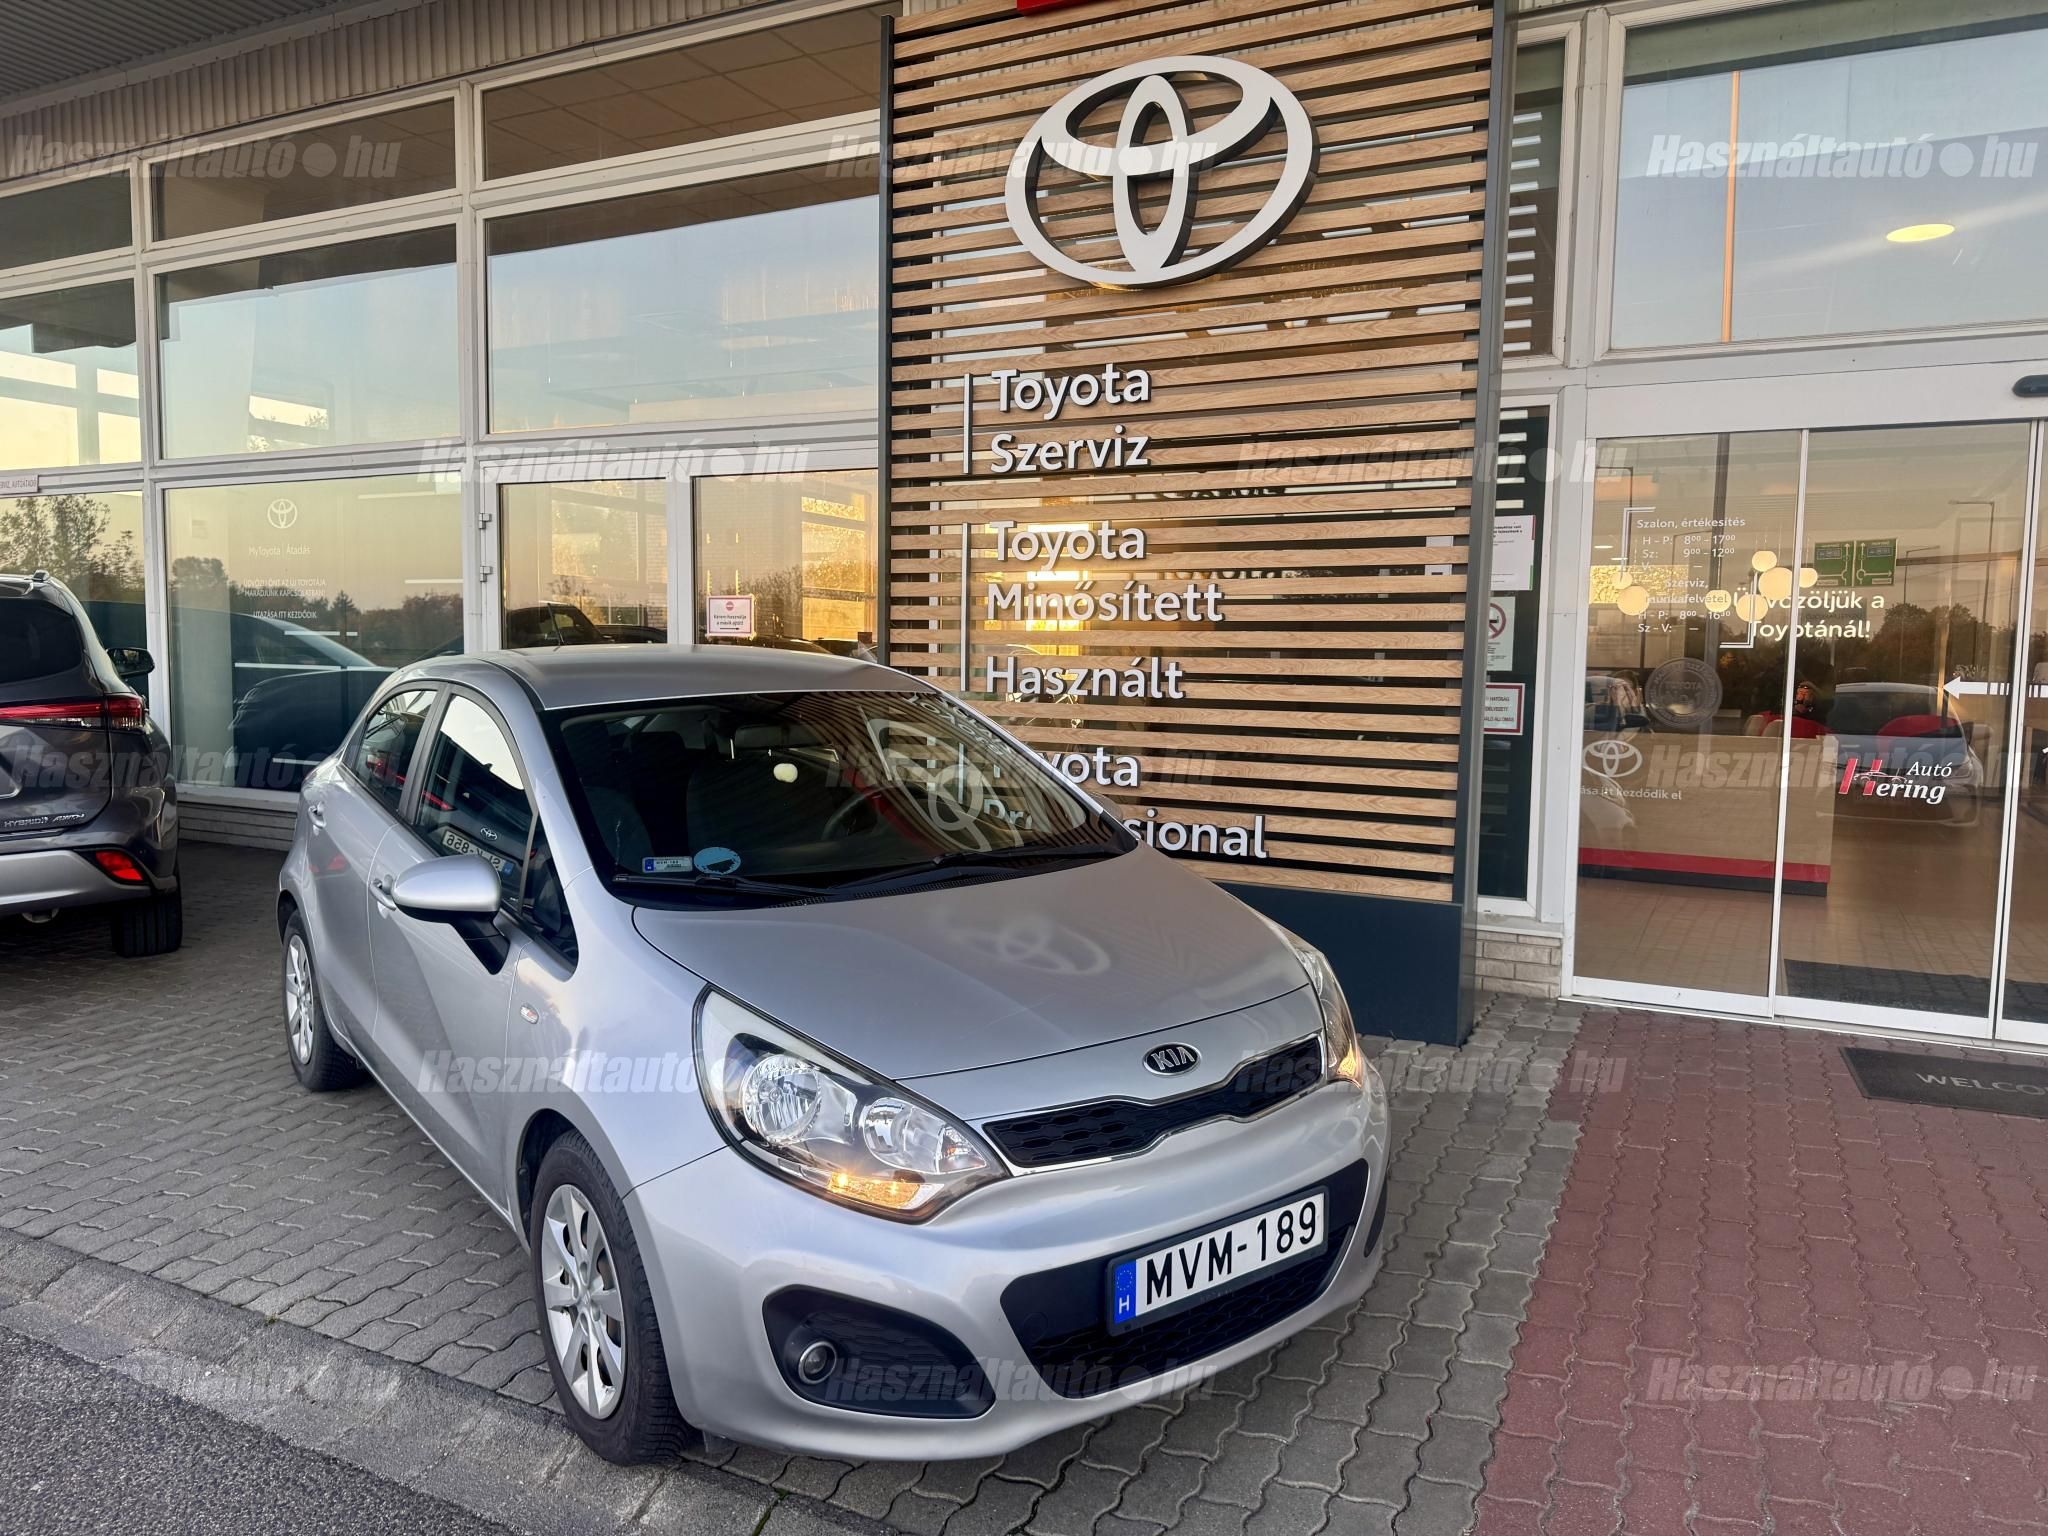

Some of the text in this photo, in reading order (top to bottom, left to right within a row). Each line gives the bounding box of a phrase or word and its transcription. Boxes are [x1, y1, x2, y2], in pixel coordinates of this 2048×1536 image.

[991, 363, 1151, 420] Toyota
[990, 424, 1151, 473] Szerviz
[1636, 517, 1746, 529] Szalon, értékesítés
[989, 519, 1146, 571] Toyota
[1647, 593, 1728, 604] munkafelvétel
[1665, 578, 1709, 589] Szerviz,
[986, 580, 1225, 622] Minősített
[1871, 595, 1885, 609] a
[985, 655, 1187, 700] Használt
[1838, 758, 1947, 805] Hering
[1906, 761, 1953, 778] Autó
[1150, 1046, 1196, 1071] KIA
[1915, 1072, 2048, 1096] WELCO
[1146, 1201, 1317, 1306] MVM-189
